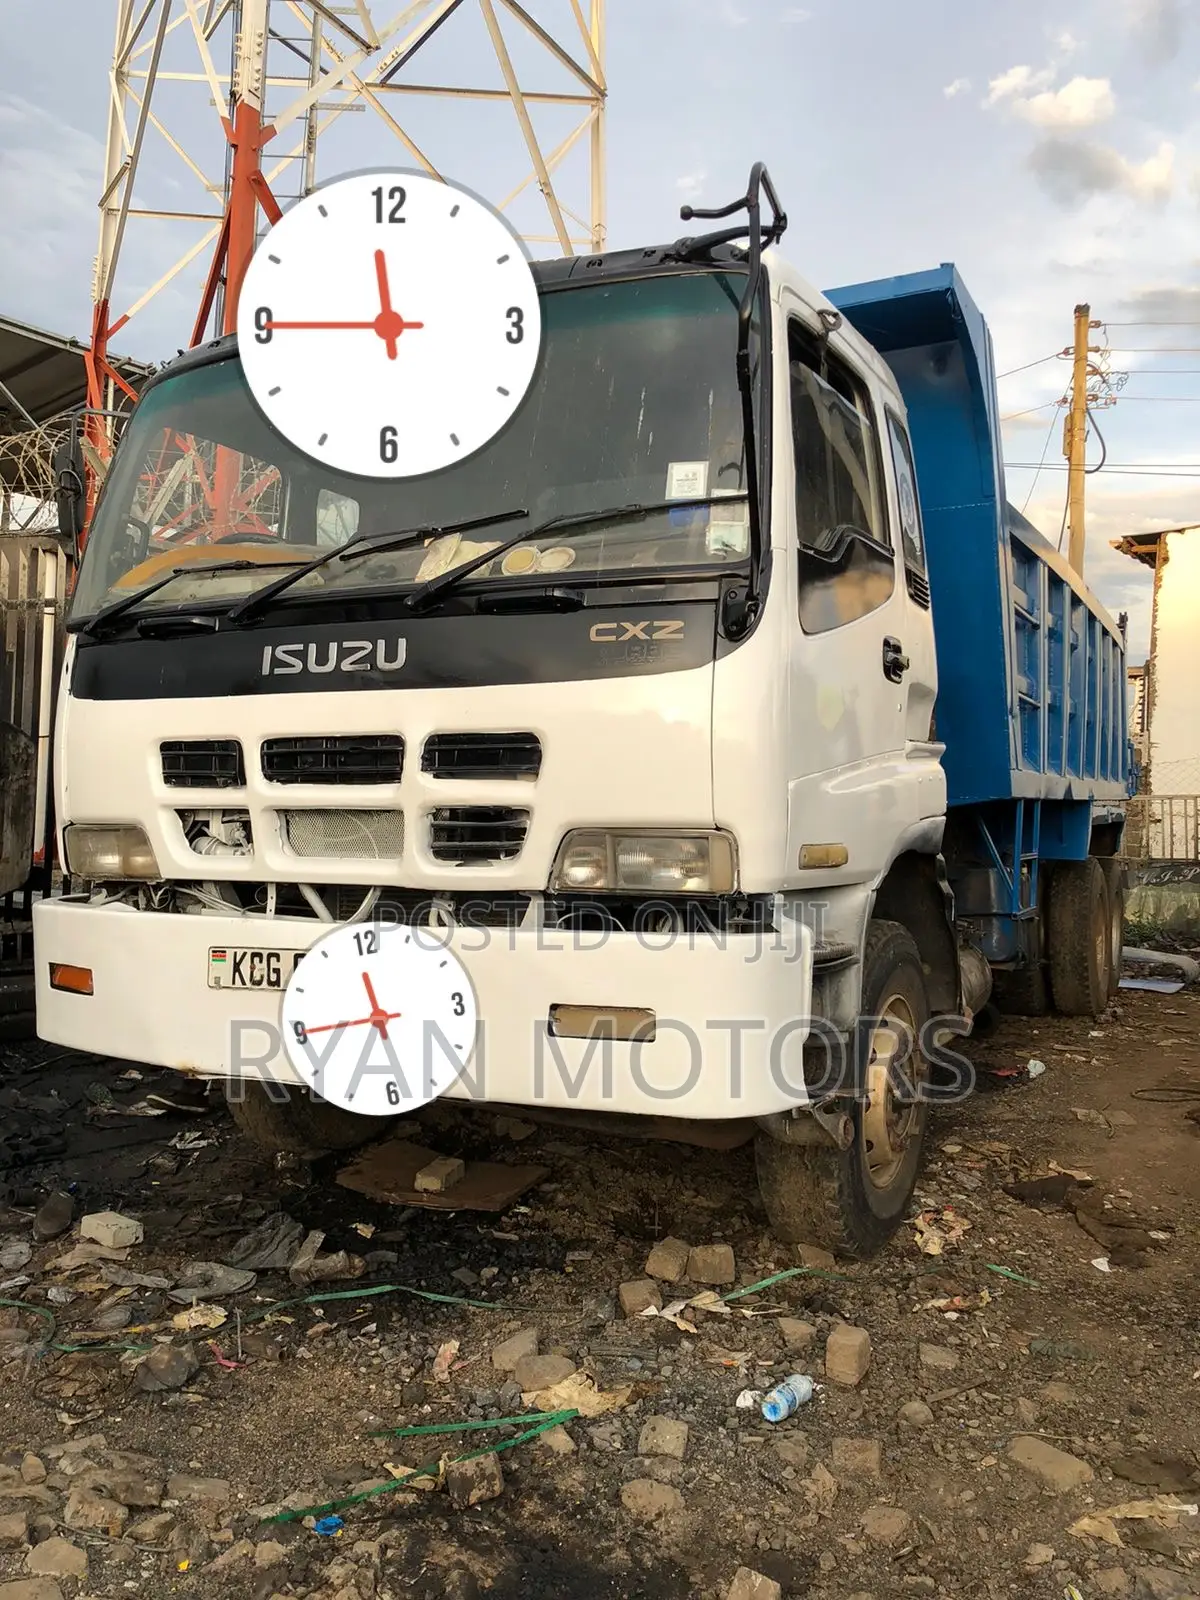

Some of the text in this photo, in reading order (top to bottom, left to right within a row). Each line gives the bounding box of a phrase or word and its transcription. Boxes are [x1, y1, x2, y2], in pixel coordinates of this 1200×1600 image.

[589, 620, 685, 642] CXZ
[262, 638, 407, 676] ISUZU
[231, 951, 281, 987] KCG
